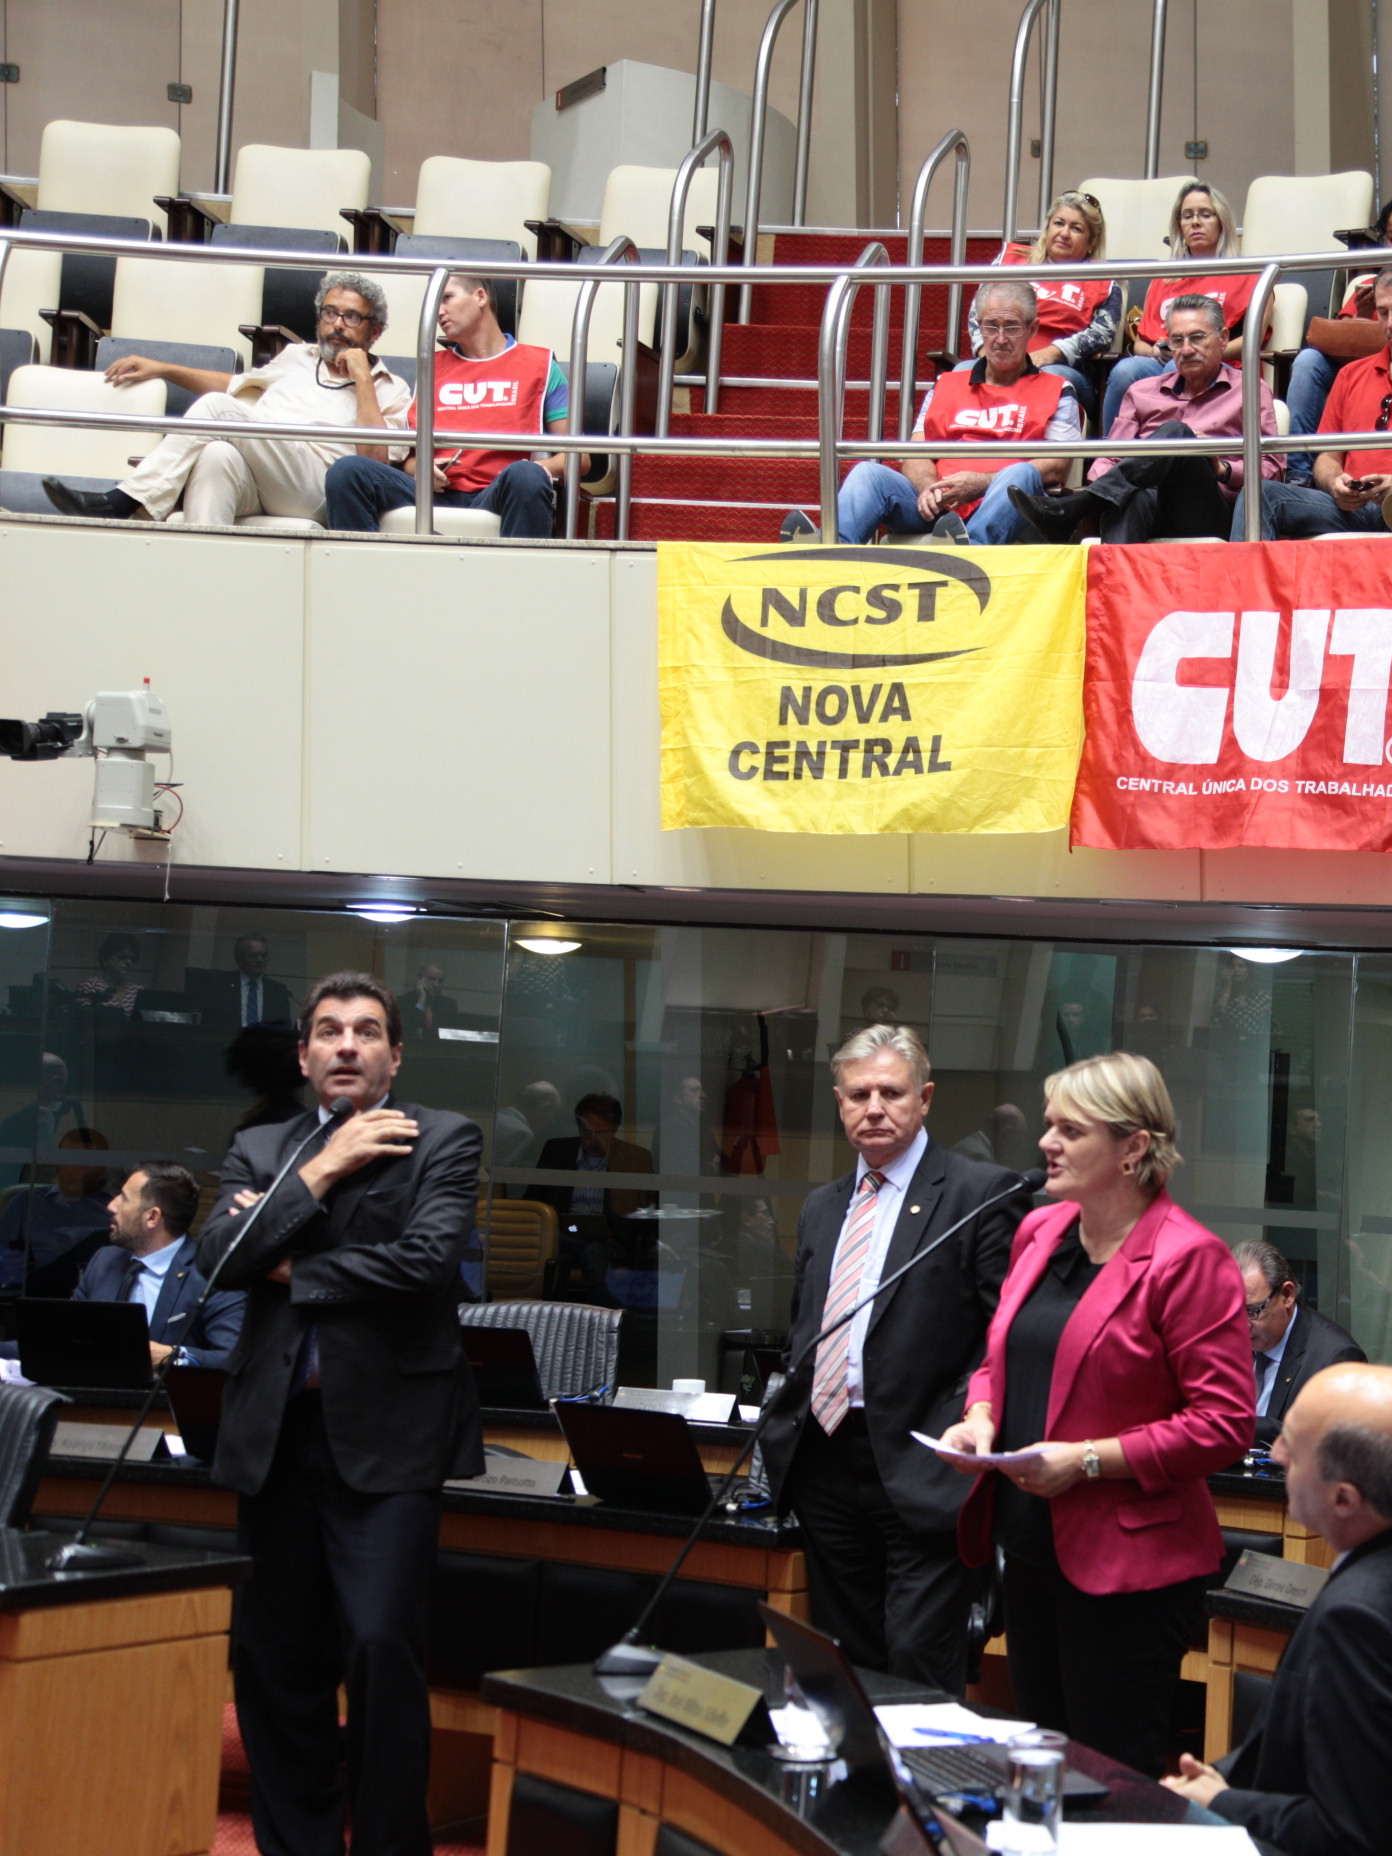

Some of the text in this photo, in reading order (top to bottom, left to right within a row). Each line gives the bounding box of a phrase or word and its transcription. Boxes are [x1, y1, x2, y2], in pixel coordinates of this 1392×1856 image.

[439, 381, 512, 405] CUT
[955, 404, 1019, 429] CUT
[760, 580, 949, 628] NCST
[778, 681, 912, 726] NOVA
[728, 734, 952, 782] CENTRAL
[1116, 776, 1198, 795] CENTRAL
[1202, 778, 1246, 795] ÚNICA
[1250, 777, 1289, 794] DOS
